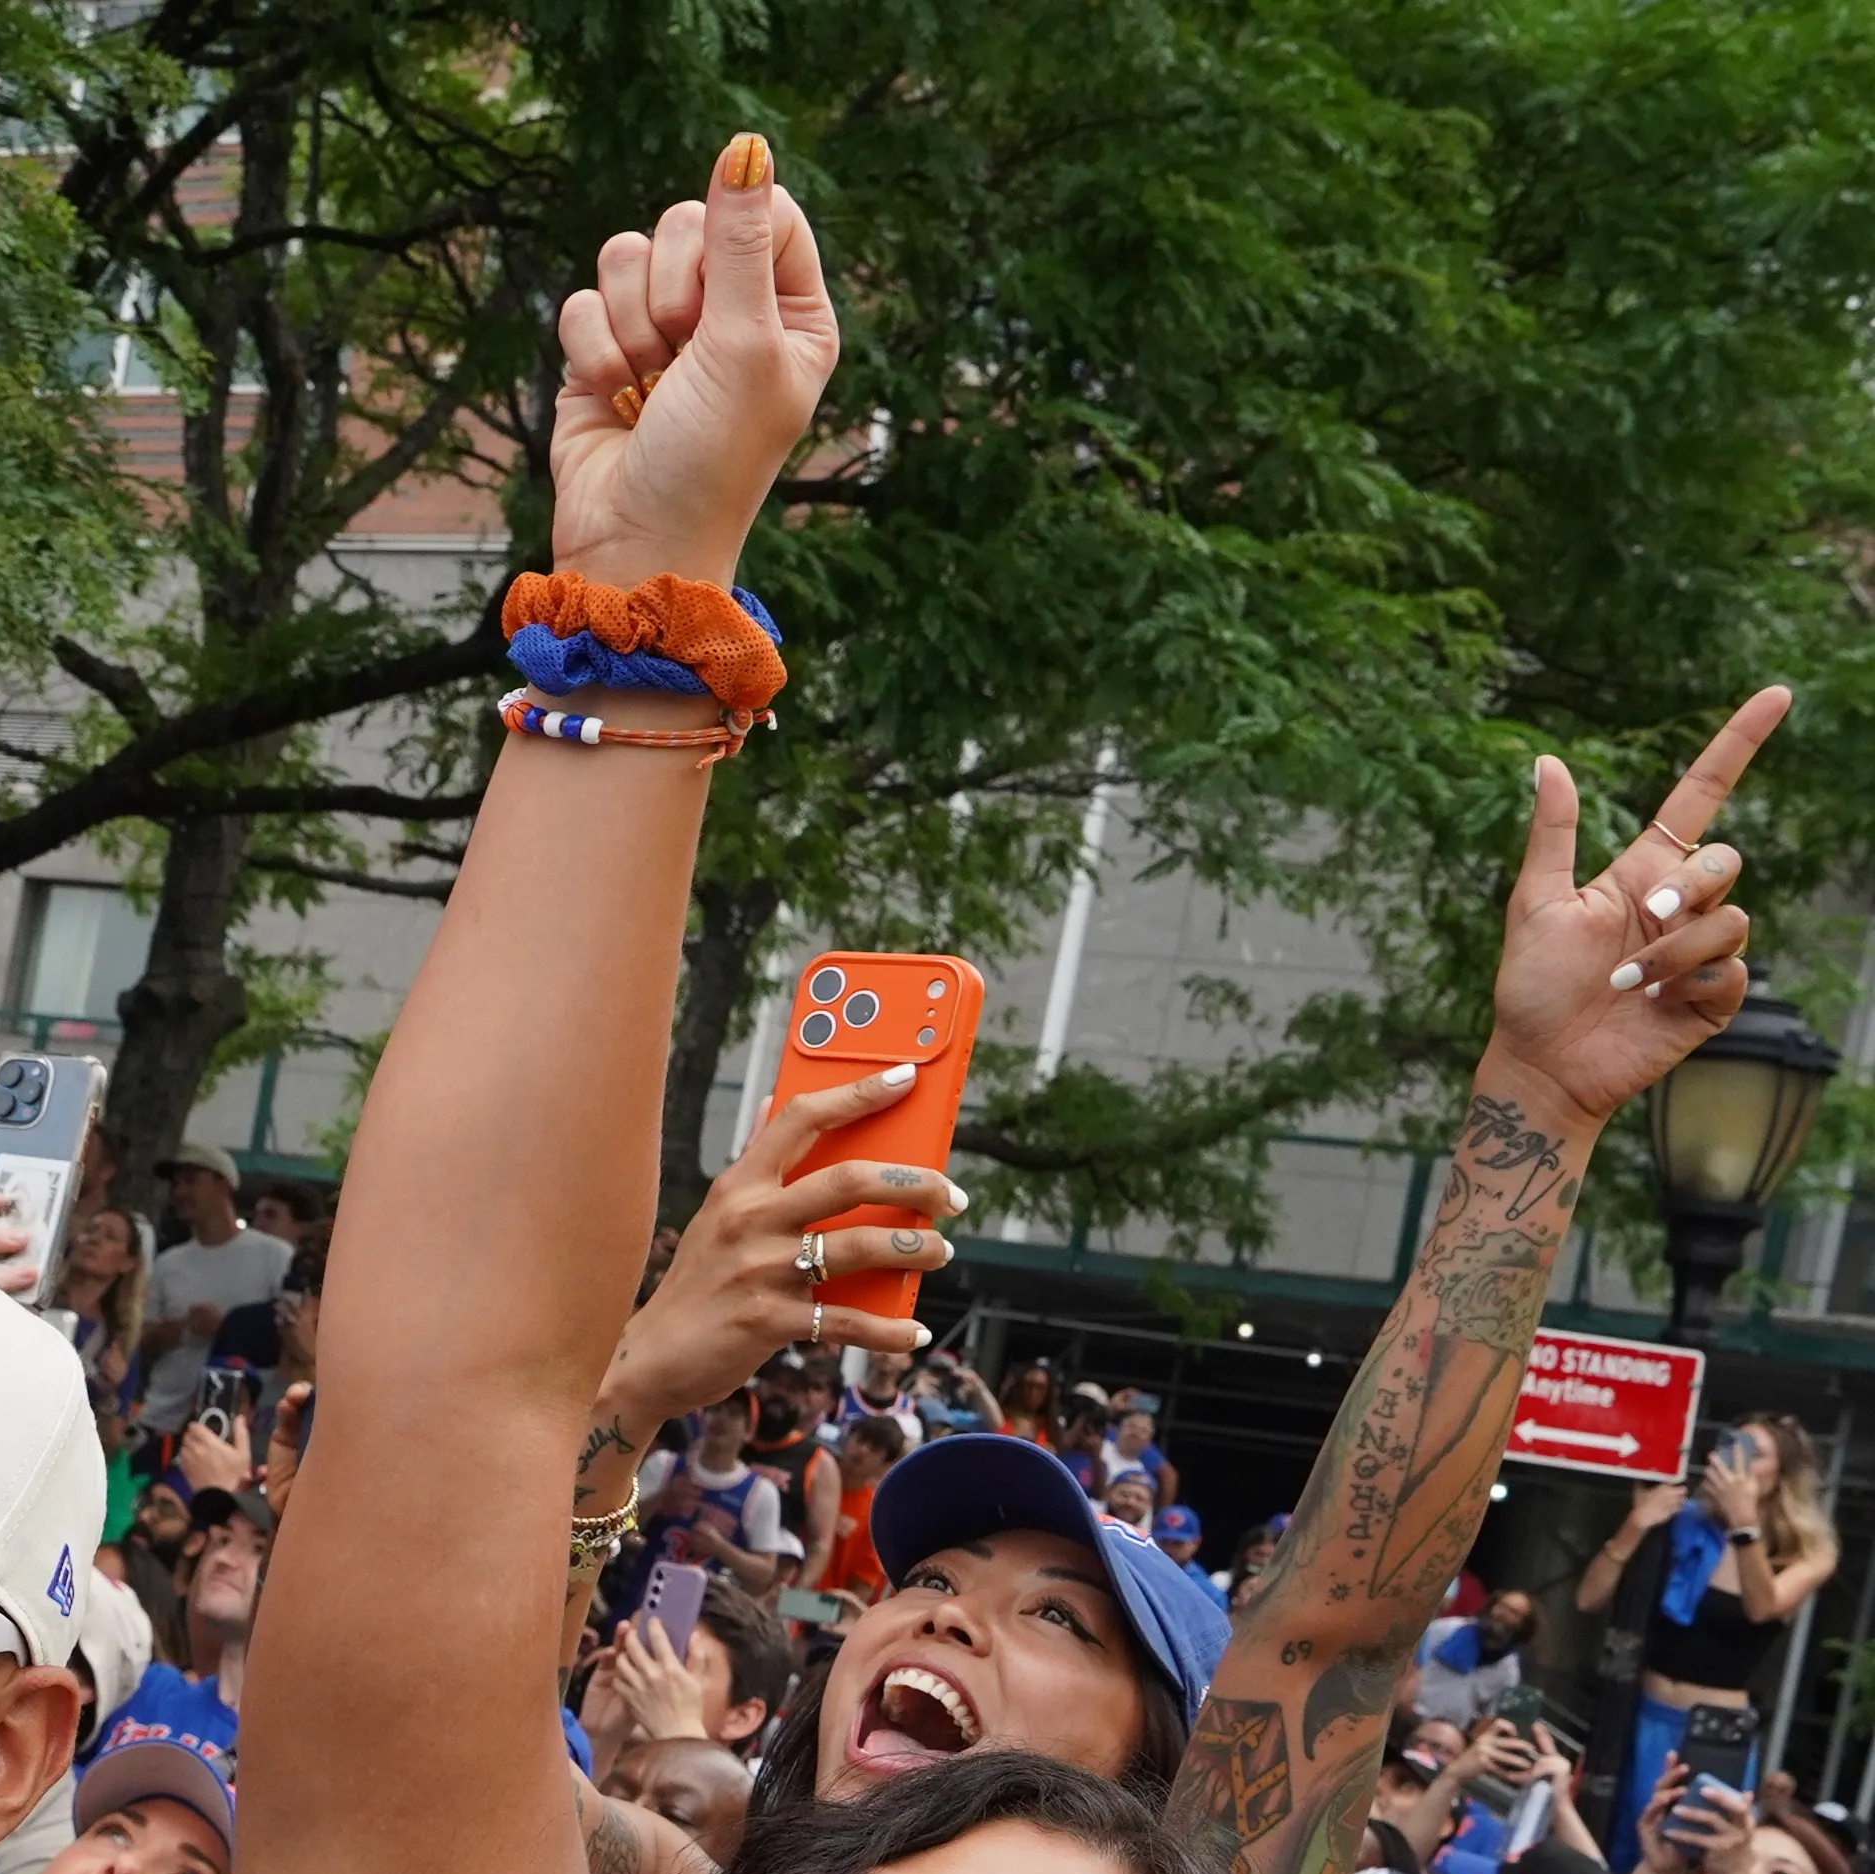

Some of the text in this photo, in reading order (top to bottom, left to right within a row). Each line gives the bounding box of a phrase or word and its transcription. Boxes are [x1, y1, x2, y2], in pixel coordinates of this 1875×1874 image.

[1561, 1347, 1671, 1387] STANDING
[1521, 1371, 1615, 1408] Anytime
[1280, 1639, 1313, 1666] 69
